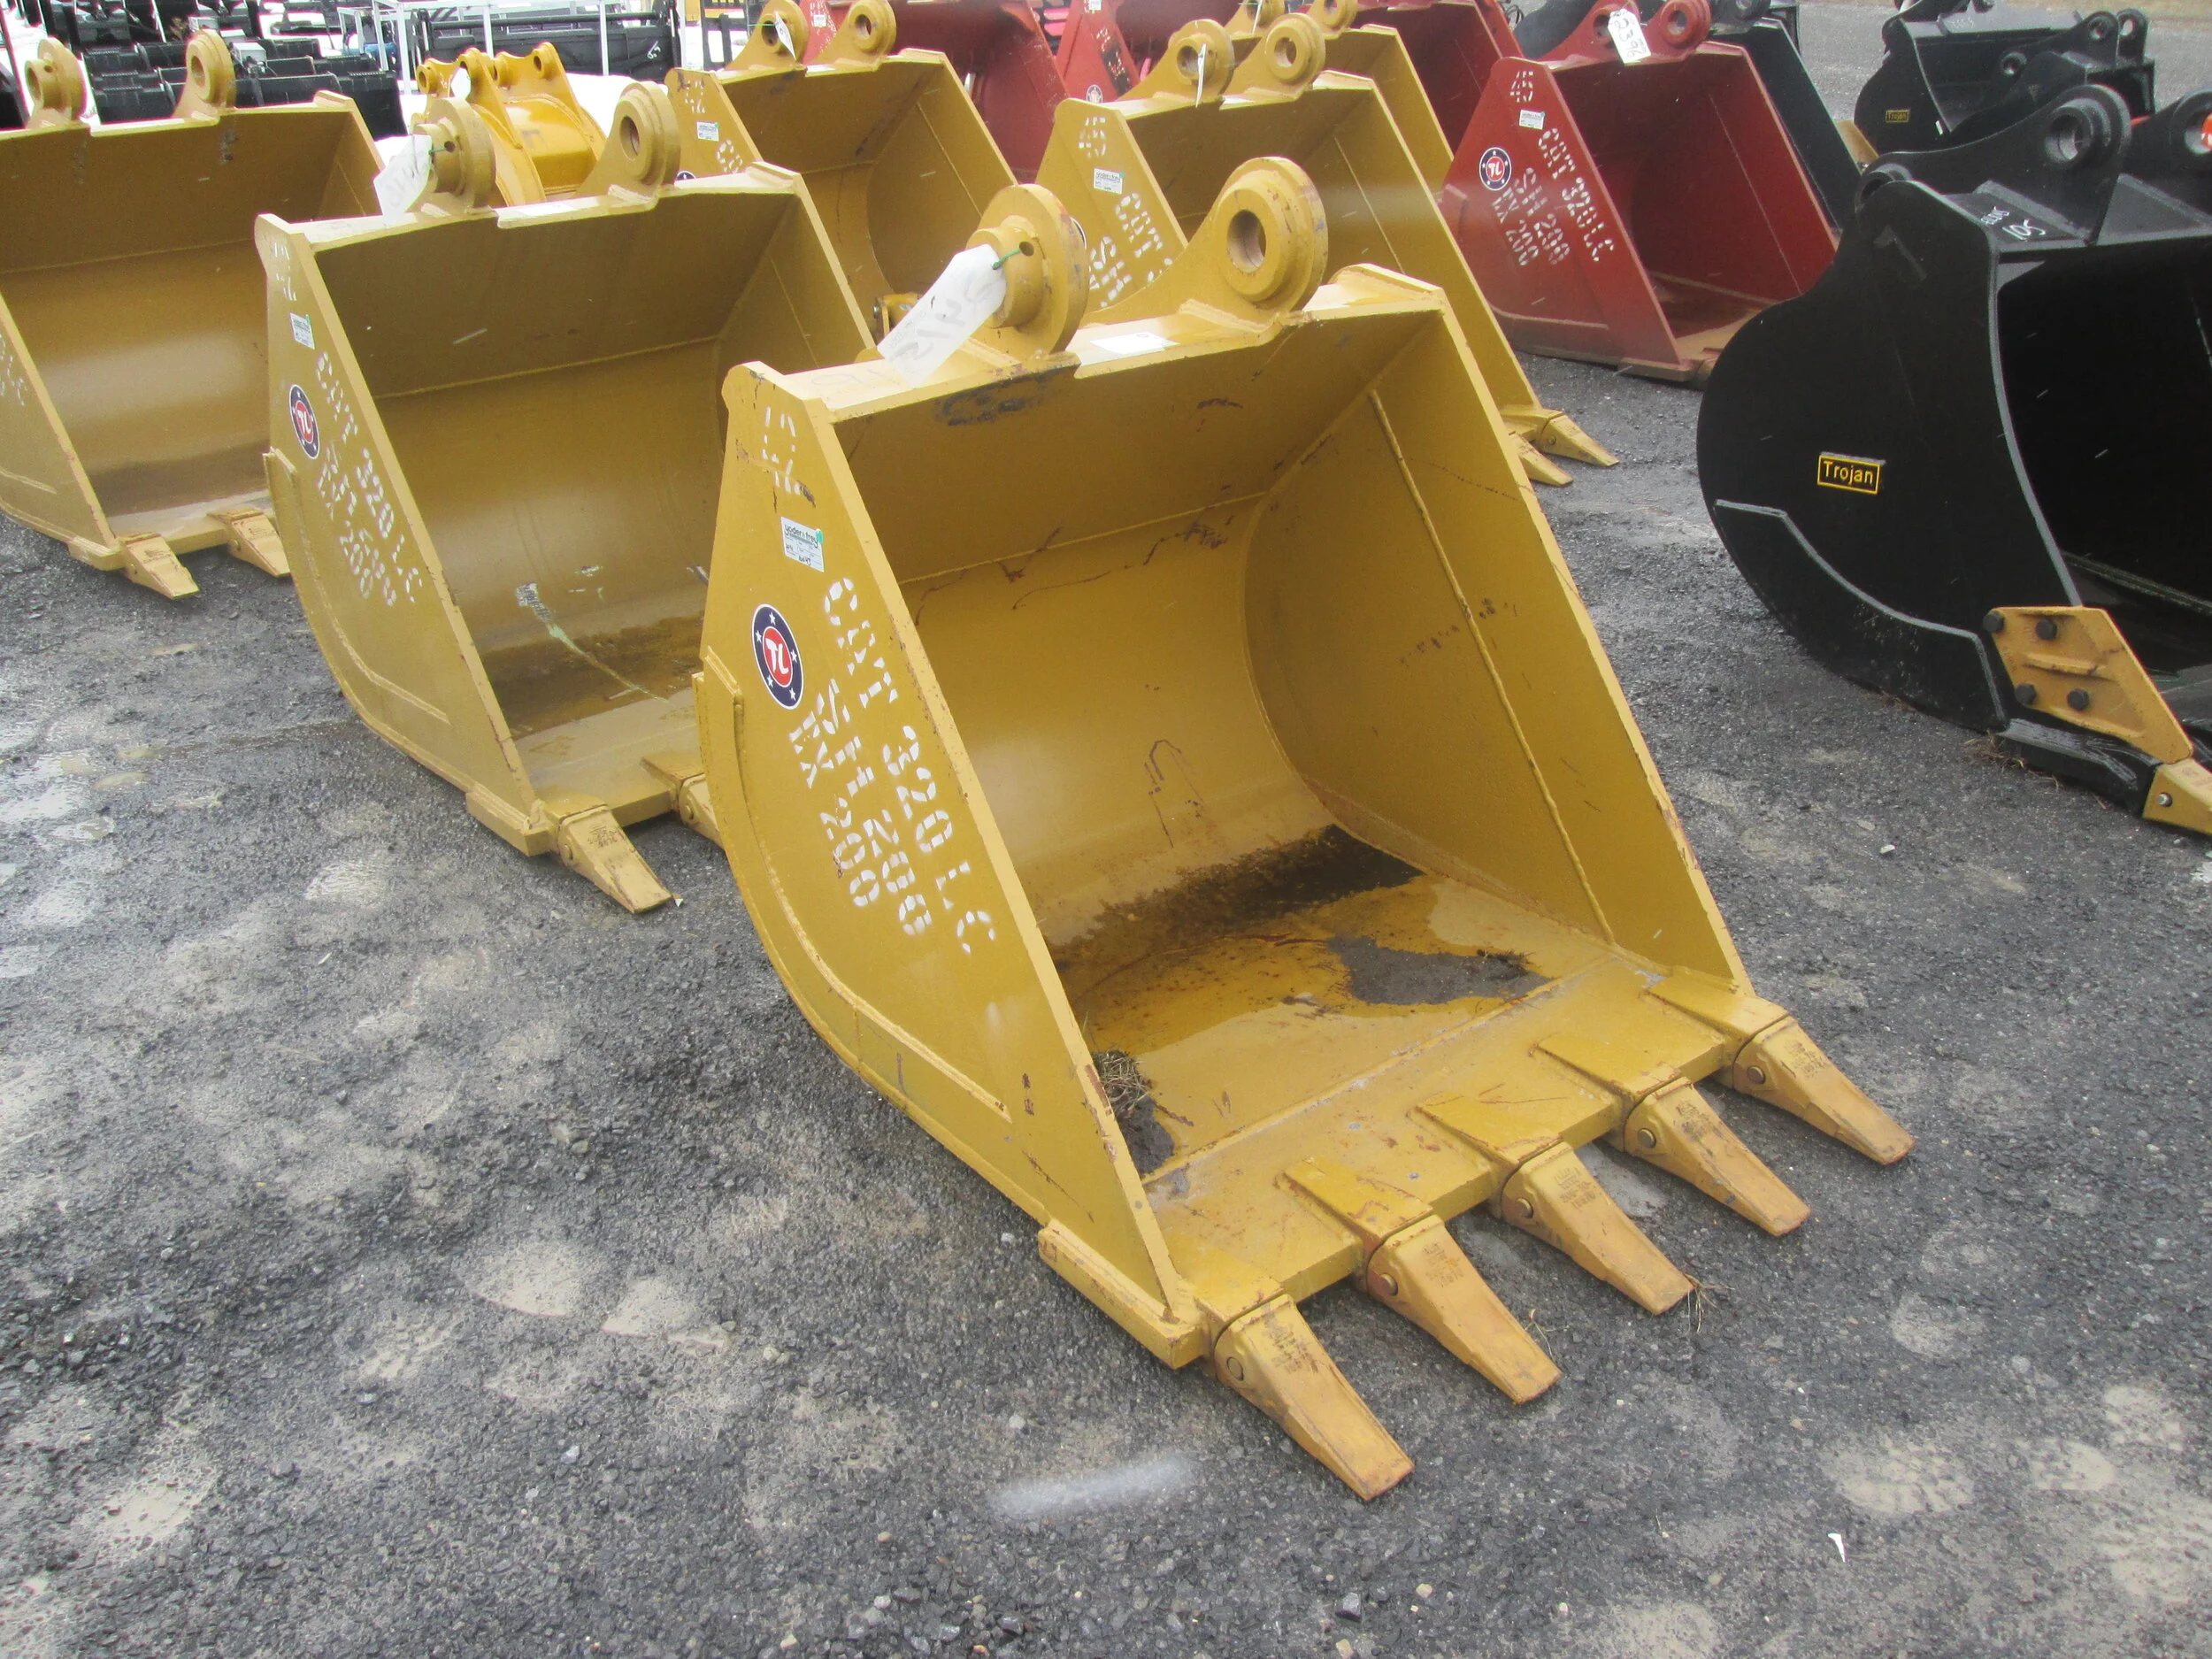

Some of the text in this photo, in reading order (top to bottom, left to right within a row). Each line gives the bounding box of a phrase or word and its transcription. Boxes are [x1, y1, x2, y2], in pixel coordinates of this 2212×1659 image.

[1538, 127, 1576, 180] CAT
[1562, 177, 1598, 228] 320
[1823, 460, 1874, 485] Trojan
[764, 637, 789, 675] TL
[788, 711, 880, 907] EX 200
[817, 679, 933, 936] SH 200
[824, 577, 996, 954] CAT 320 LC
